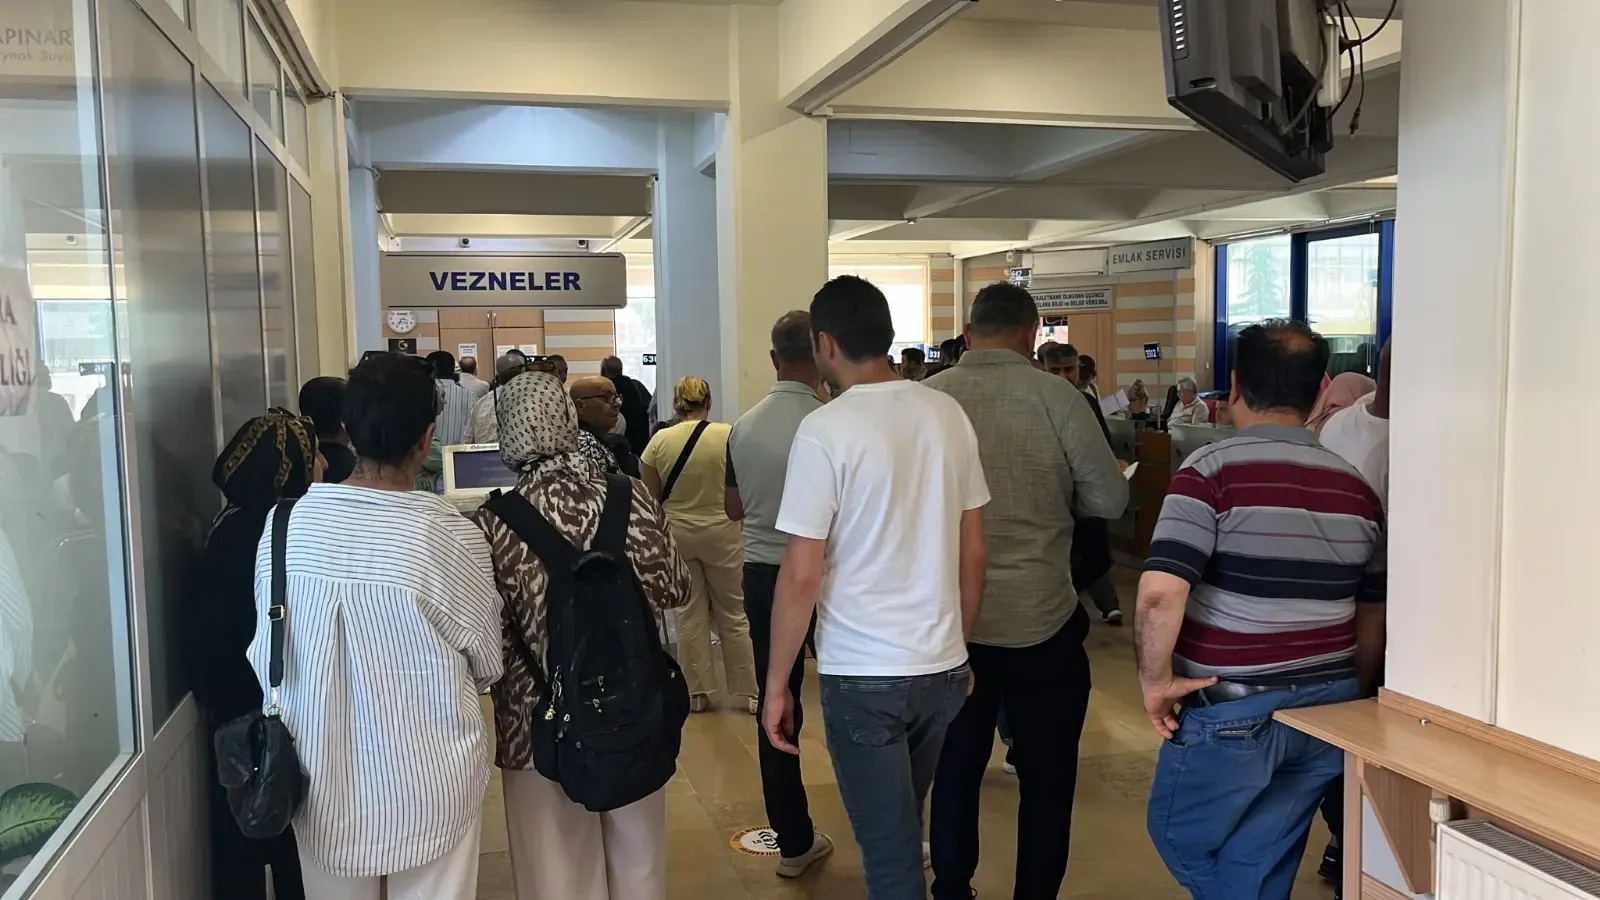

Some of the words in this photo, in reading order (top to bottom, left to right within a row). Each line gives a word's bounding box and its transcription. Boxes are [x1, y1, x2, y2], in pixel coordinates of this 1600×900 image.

[0, 28, 73, 46] PINAR
[1113, 252, 1142, 265] EMLAK
[1145, 244, 1187, 261] SERVİSİ
[429, 271, 582, 291] VEZNELER
